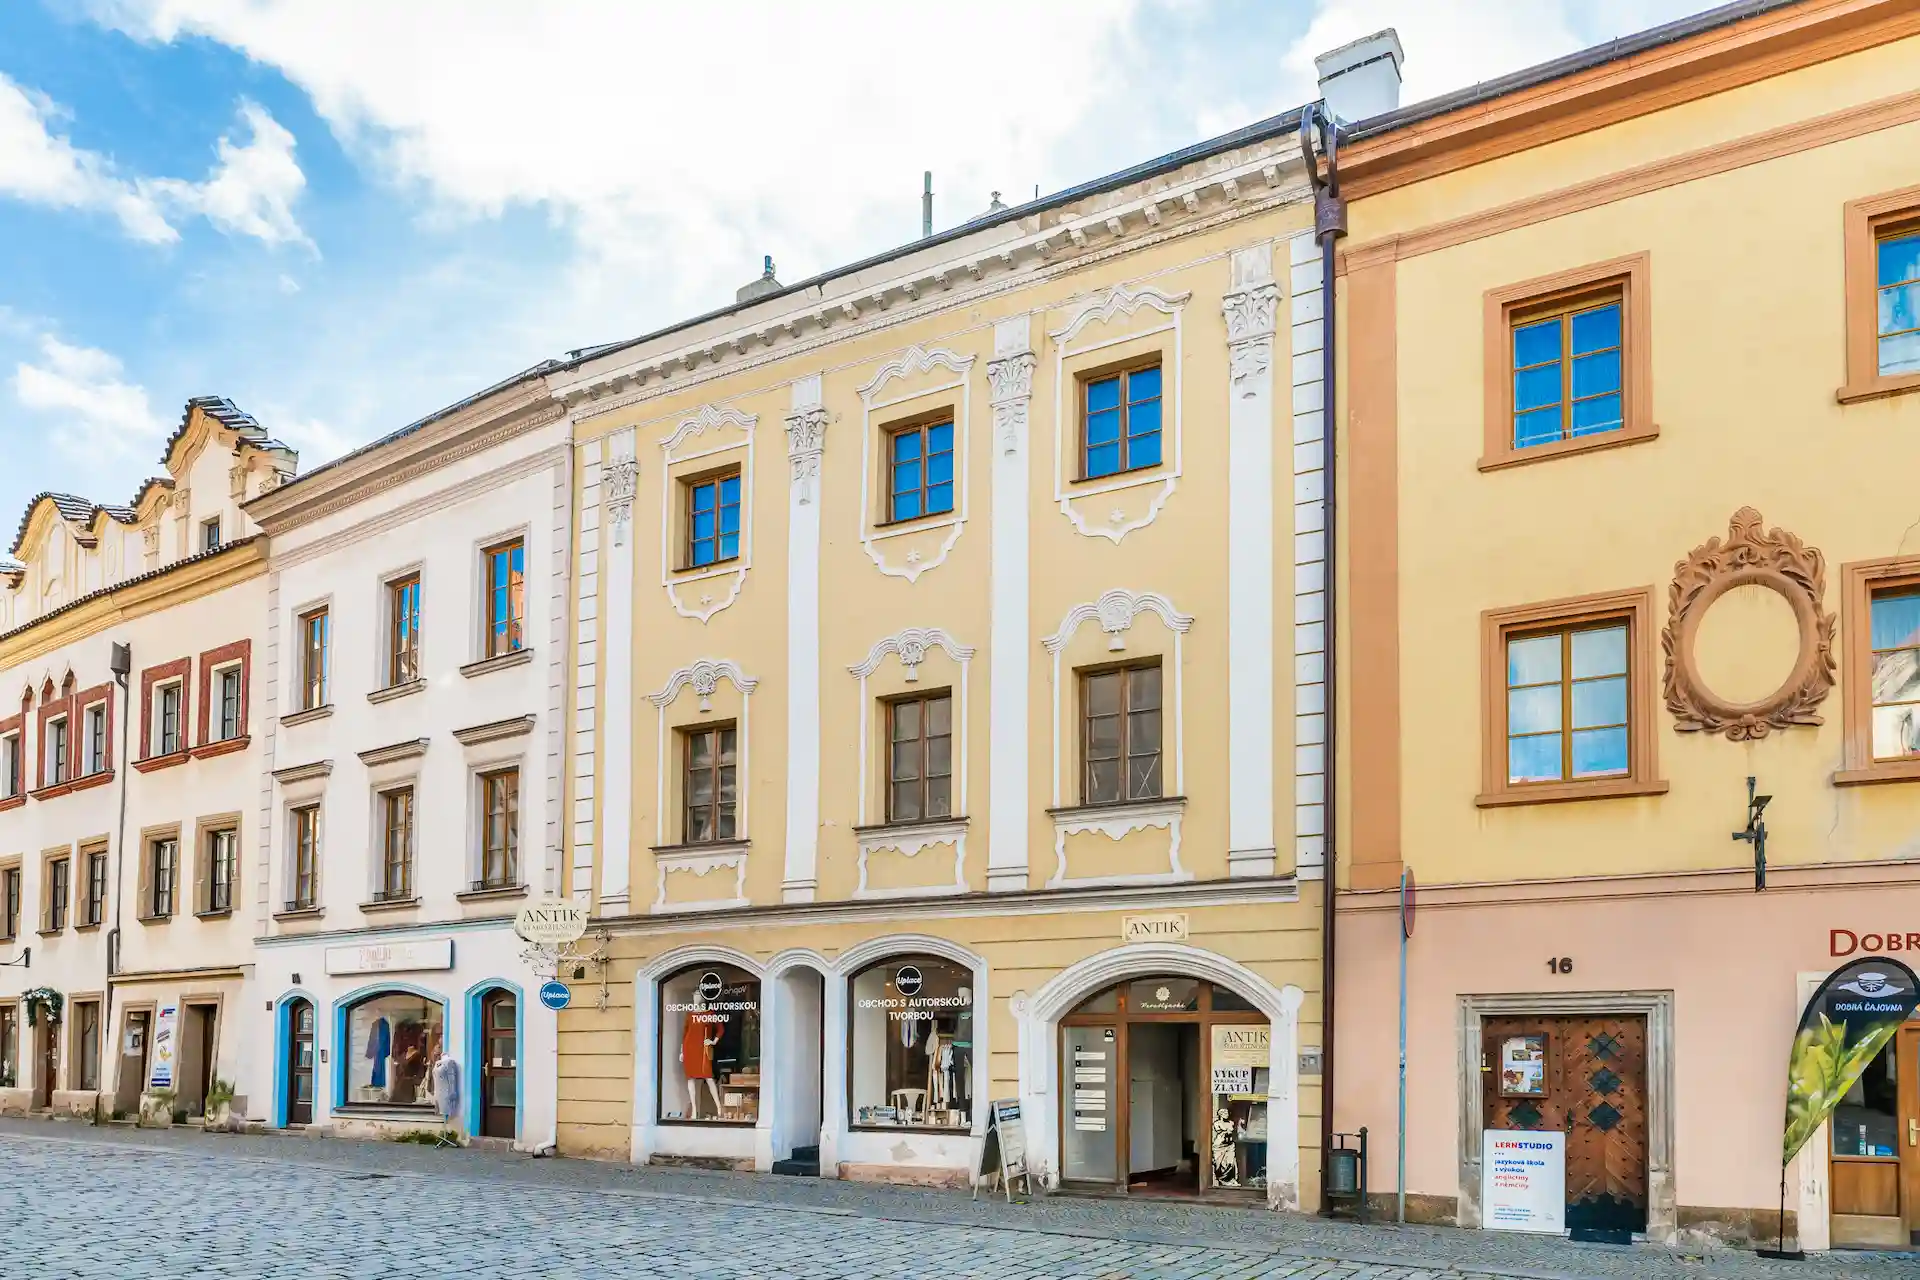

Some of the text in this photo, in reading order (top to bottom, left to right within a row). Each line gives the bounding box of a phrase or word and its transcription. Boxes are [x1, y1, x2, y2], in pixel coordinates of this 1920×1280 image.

[523, 909, 580, 922] ANTIK
[1129, 921, 1180, 934] ANTIK
[1830, 929, 1920, 957] DOBR
[1547, 957, 1573, 974] 16
[665, 1001, 757, 1012] OBCHOD S AUTORSKOU
[858, 997, 966, 1008] OBCHOD S AUTORSKOU
[1835, 1002, 1903, 1012] DOBRÁ ČAJOVNA
[691, 1014, 730, 1023] TVORBOU
[889, 1011, 934, 1021] TVORBOU
[1224, 1031, 1269, 1043] ANTIK
[1214, 1084, 1249, 1092] ZLATA
[1495, 1141, 1553, 1150] LERNSTUDIO
